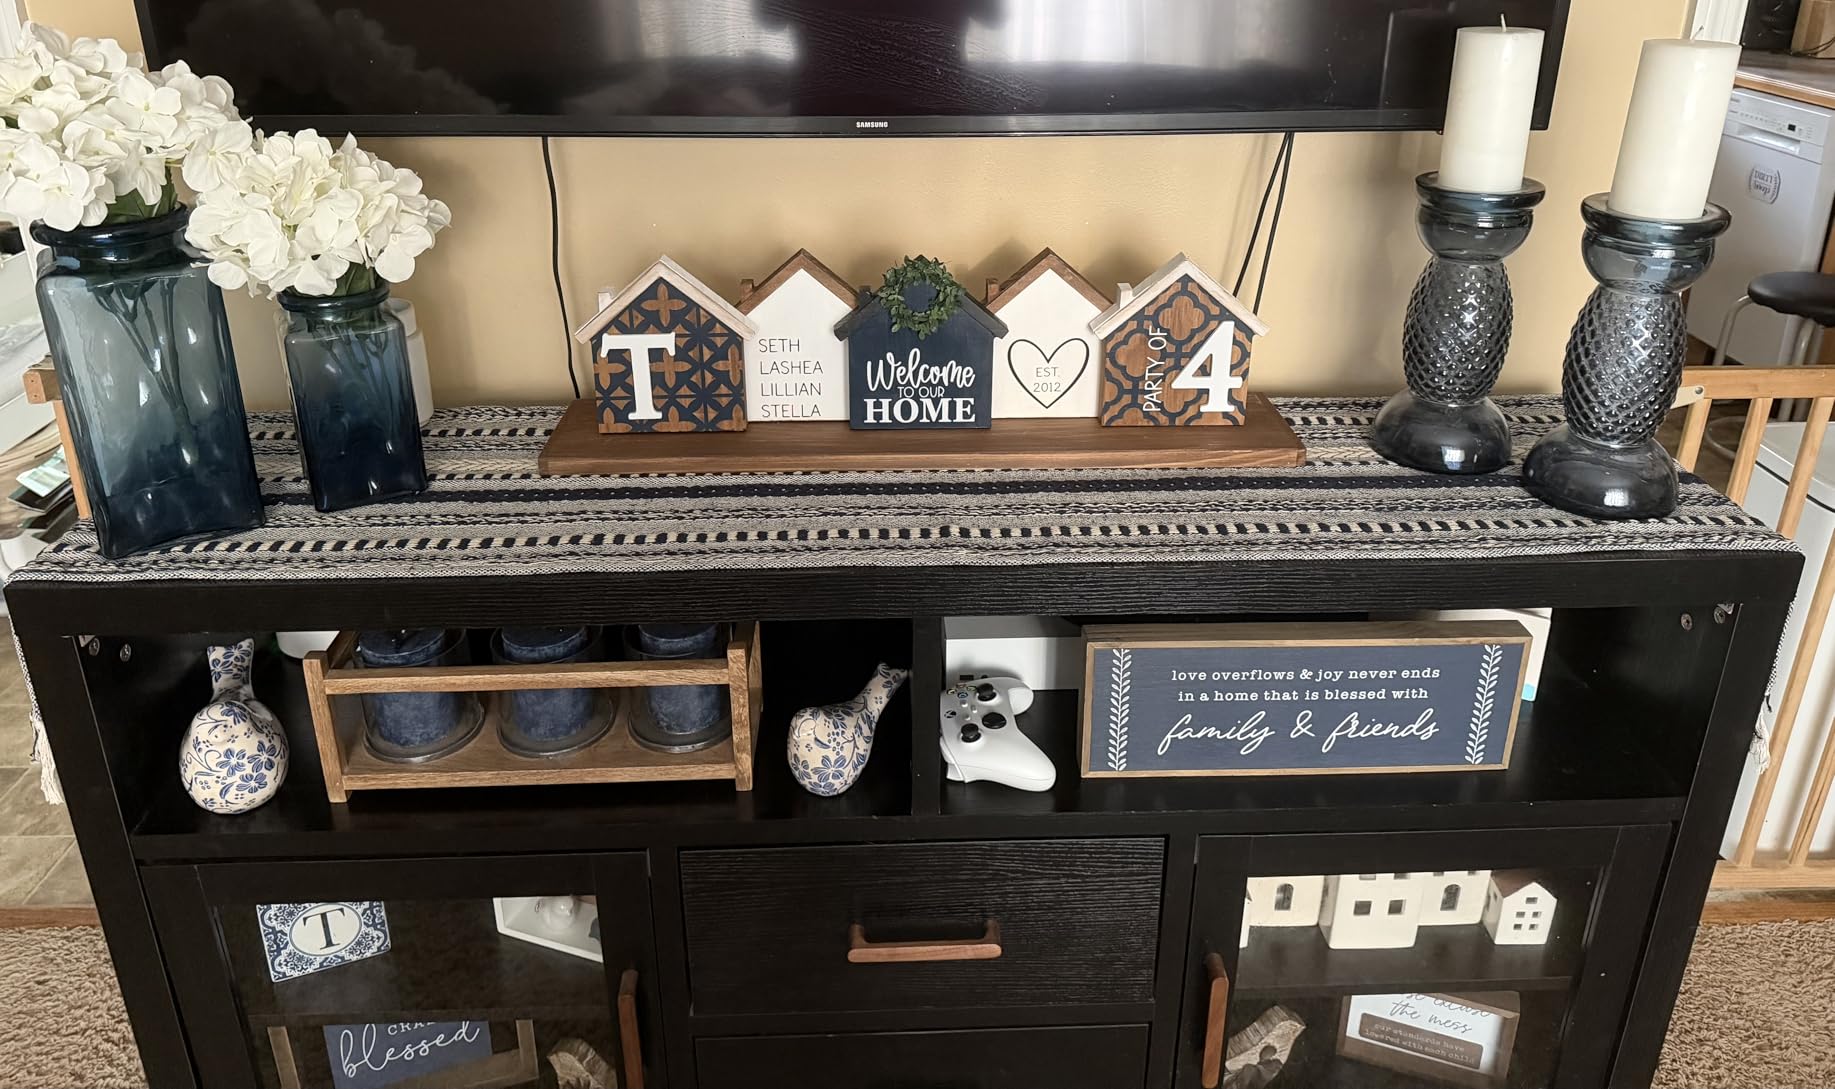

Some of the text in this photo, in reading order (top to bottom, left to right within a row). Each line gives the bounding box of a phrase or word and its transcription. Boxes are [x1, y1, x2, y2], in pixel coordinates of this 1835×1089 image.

[758, 338, 800, 353] SETH
[601, 332, 676, 420] T
[760, 360, 823, 375] LASHEA
[866, 348, 976, 391] Welcome
[1035, 366, 1060, 378] EST.
[1142, 325, 1167, 411] PARTY OF
[1171, 321, 1243, 412] 4
[760, 382, 822, 397] LILLIAN
[897, 386, 945, 398] TO OUR
[1033, 382, 1062, 393] 2012
[761, 404, 822, 418] STELLA
[863, 397, 976, 424] HOME
[1171, 667, 1440, 682] love overflows & joy never ends
[1178, 688, 1429, 702] in a home that is blessed with
[1157, 708, 1440, 756] family & friends
[302, 907, 346, 950] T
[1390, 1000, 1473, 1034] the mess
[340, 1021, 480, 1078] blessed
